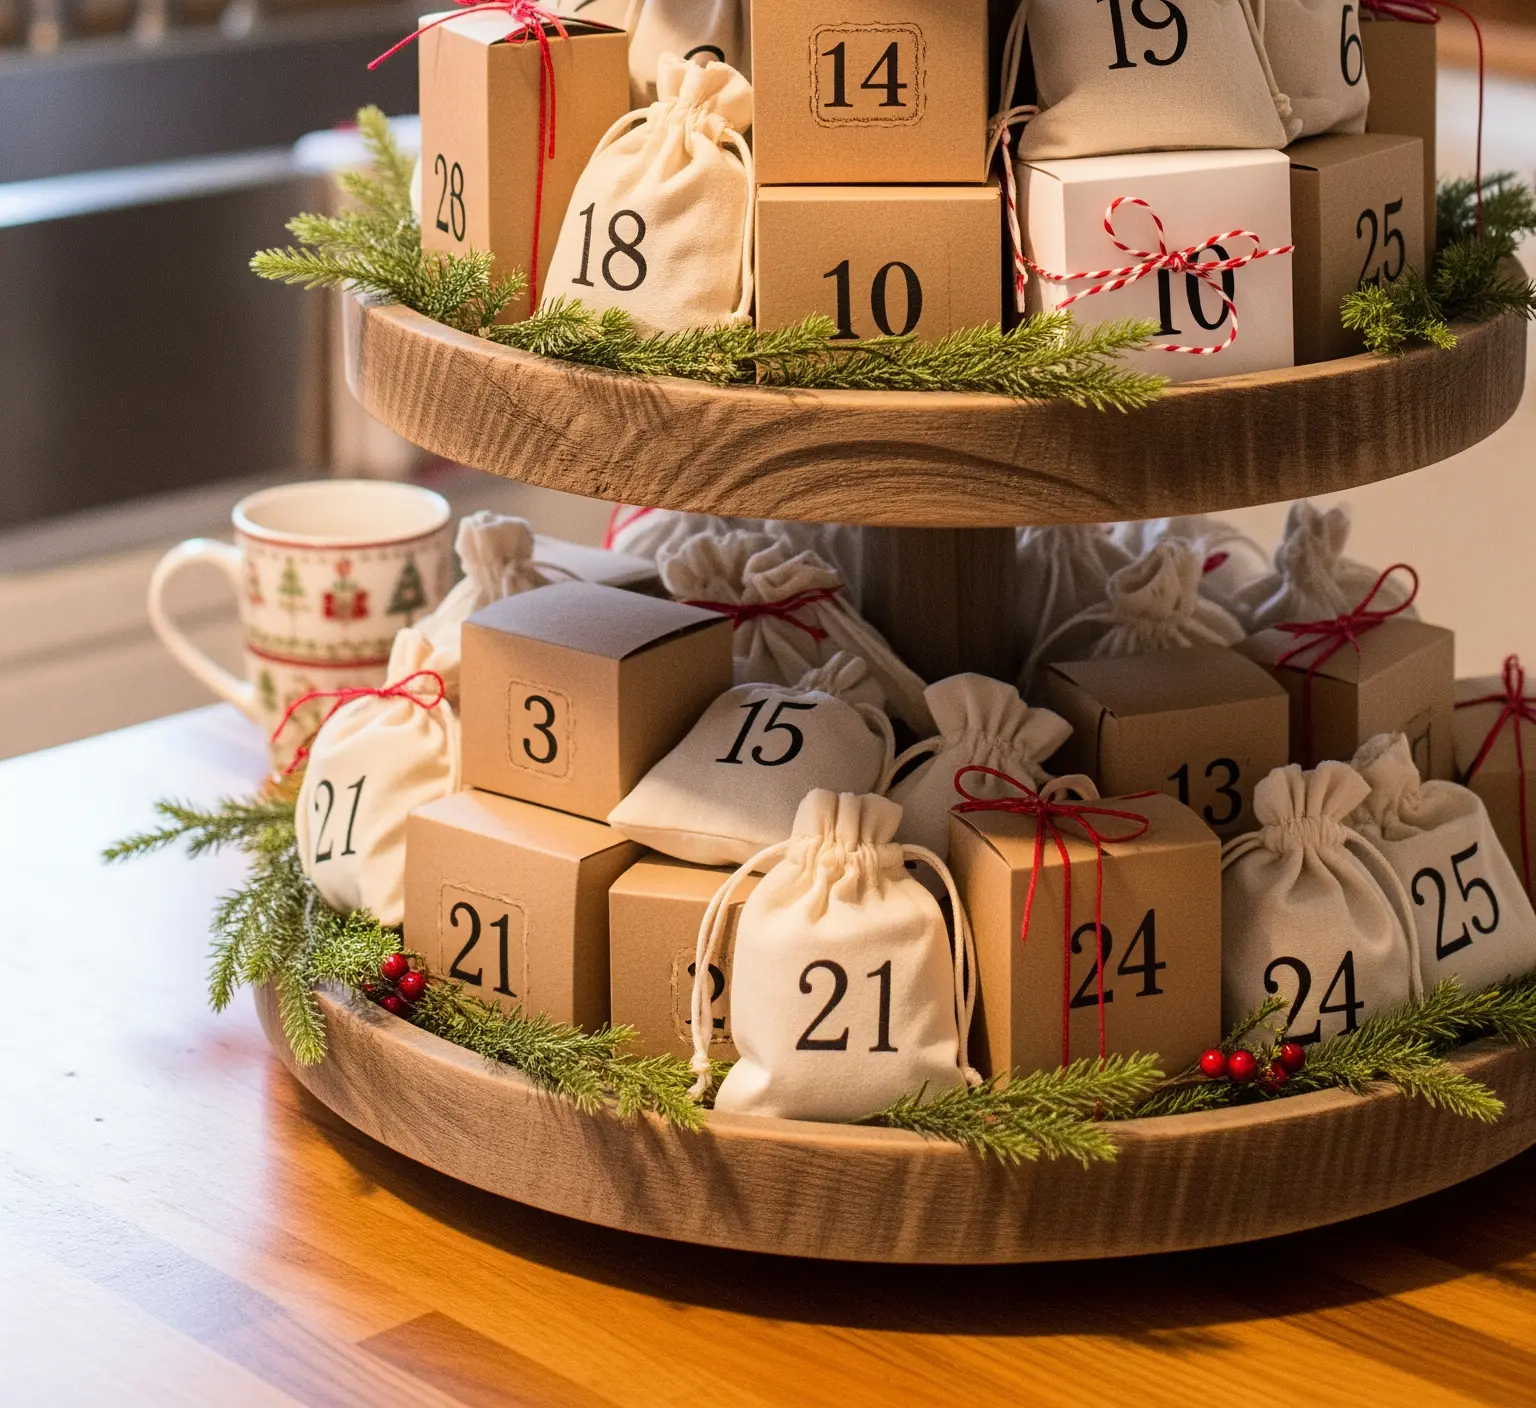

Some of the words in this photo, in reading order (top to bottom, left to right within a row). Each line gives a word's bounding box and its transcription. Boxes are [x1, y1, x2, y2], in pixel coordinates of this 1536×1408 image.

[821, 41, 908, 108] 14
[1339, 4, 1365, 87] 6
[434, 153, 466, 242] 28
[571, 202, 648, 292] 18
[1356, 196, 1406, 292] 25
[822, 259, 924, 341] 10
[522, 694, 559, 765] 3
[715, 700, 818, 768] 15
[313, 775, 368, 864] 21
[1167, 757, 1242, 826] 13
[1411, 841, 1500, 962] 25
[449, 901, 518, 998] 21
[1068, 908, 1167, 1009] 24
[796, 959, 899, 1054] 21
[1263, 950, 1365, 1047] 24
